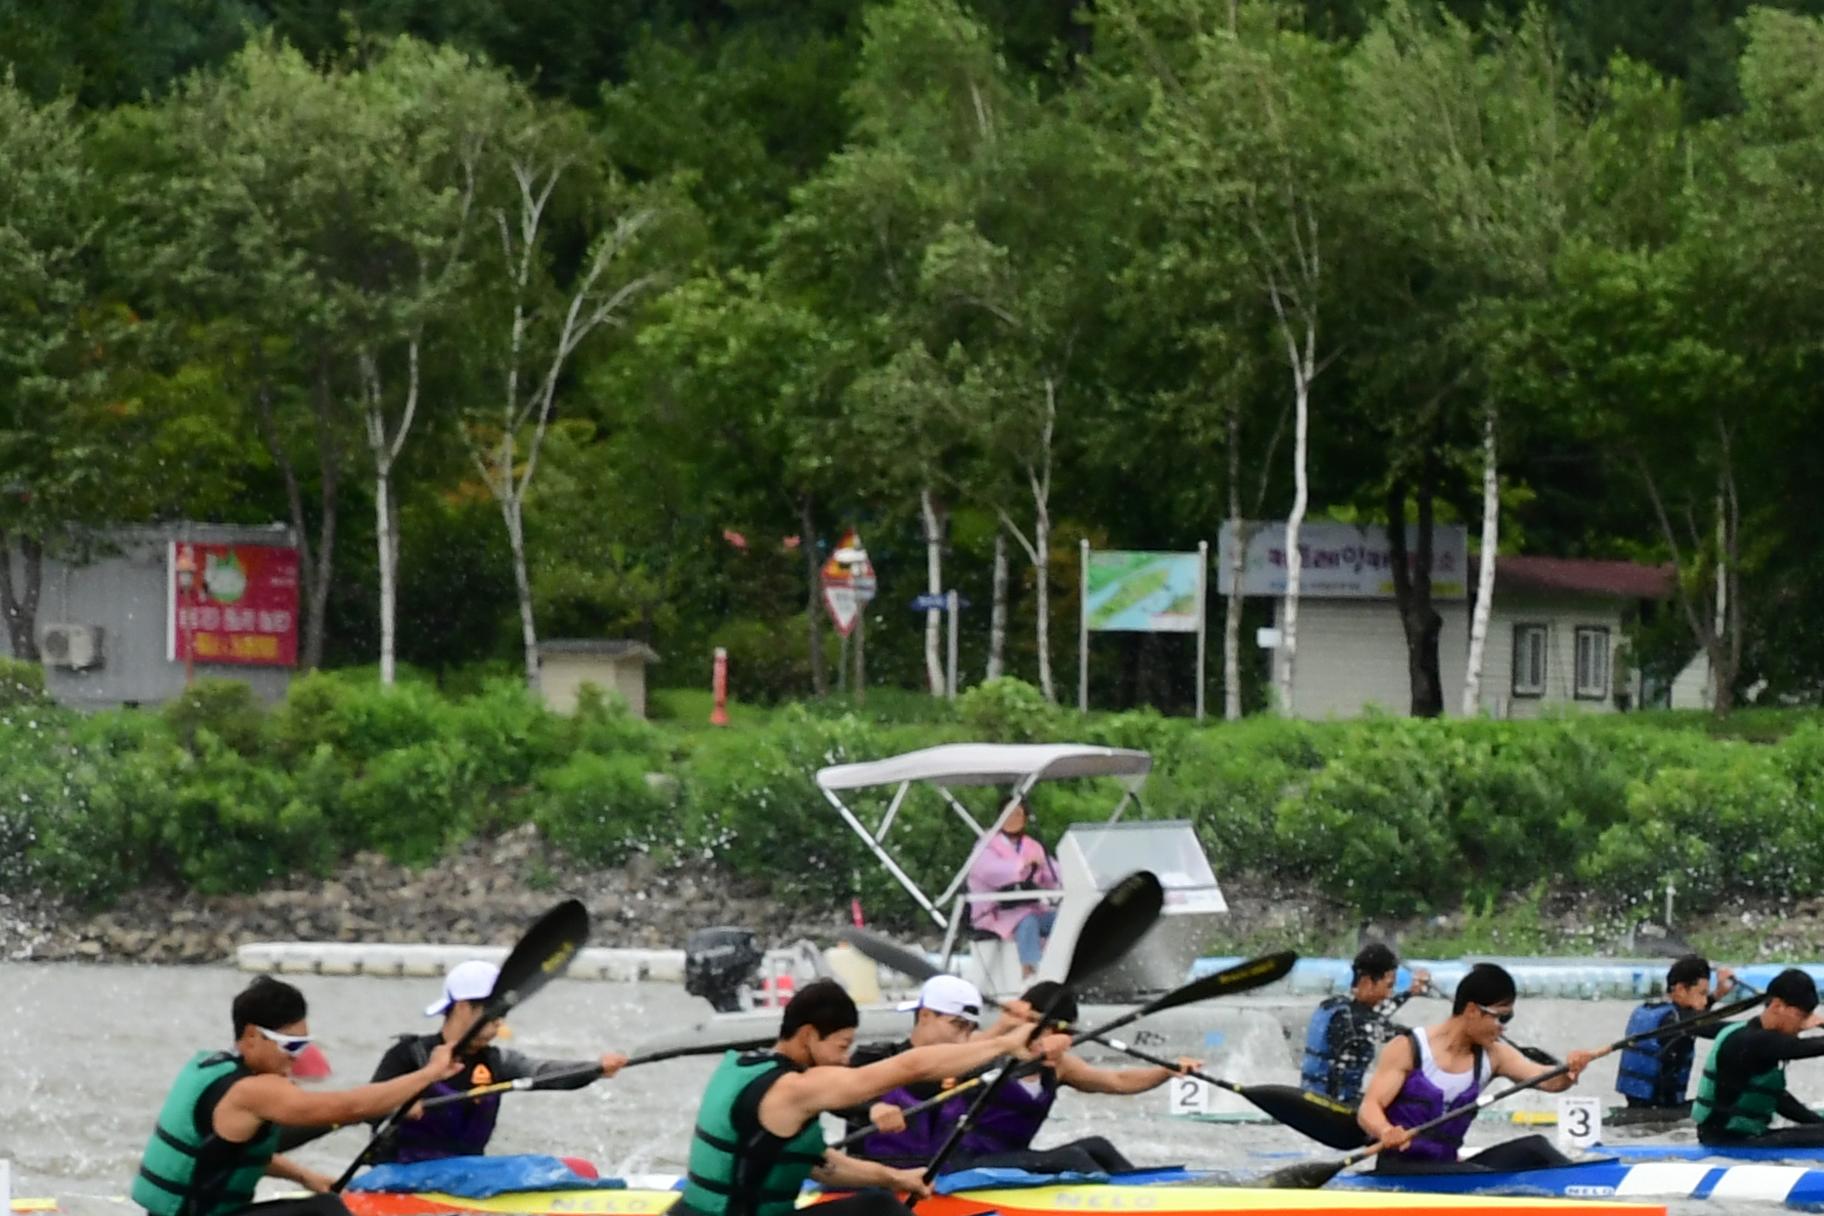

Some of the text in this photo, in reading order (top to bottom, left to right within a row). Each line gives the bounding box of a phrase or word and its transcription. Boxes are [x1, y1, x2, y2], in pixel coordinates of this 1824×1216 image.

[1179, 1081, 1200, 1107] 2
[1567, 1106, 1591, 1138] 3
[1055, 1191, 1154, 1208] NELO
[1567, 1187, 1615, 1196] NELO
[550, 1197, 649, 1211] NELO
